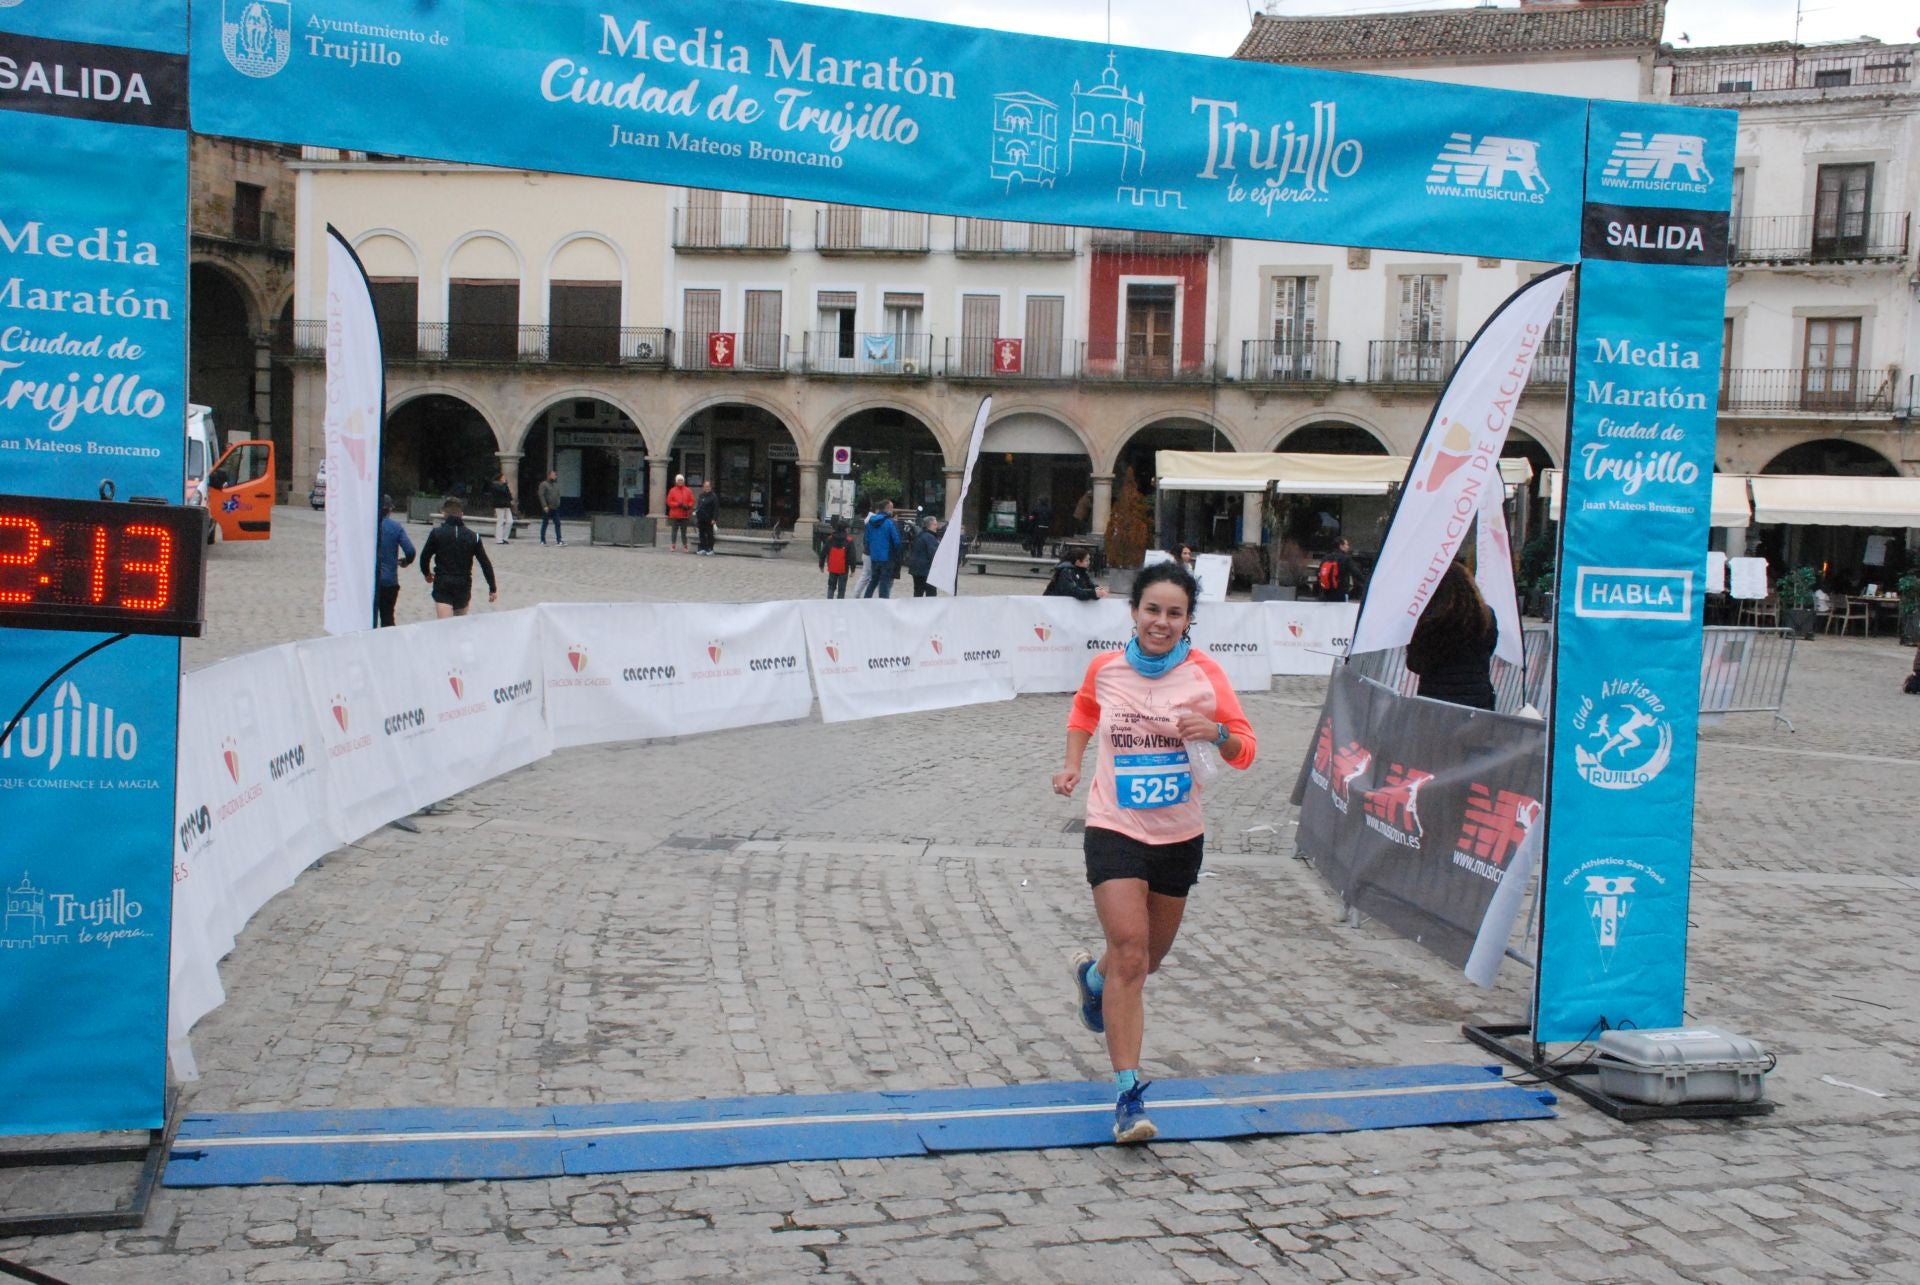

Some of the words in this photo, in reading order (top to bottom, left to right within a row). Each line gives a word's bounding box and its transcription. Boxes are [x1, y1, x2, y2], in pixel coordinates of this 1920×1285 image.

[307, 13, 424, 43] Ayuntamiento
[429, 30, 449, 46] de
[304, 34, 402, 69] Trujillo
[598, 14, 750, 75] Media
[765, 38, 957, 100] Maratón
[0, 54, 151, 106] SALIDA
[539, 58, 701, 118] Ciudad
[707, 84, 763, 124] de
[774, 87, 919, 153] Trujillo
[609, 124, 660, 149] Juan
[666, 131, 742, 158] Mateos
[748, 142, 844, 169] Broncano
[1191, 96, 1362, 192] Trujillo
[1228, 174, 1248, 204] te
[1426, 184, 1544, 205] www.musicrun.es
[1601, 176, 1707, 194] www.musicrun.es
[0, 221, 160, 267] Media
[1606, 221, 1704, 252] SALIDA
[0, 277, 171, 321] Maratón
[1, 326, 105, 357] Ciudad
[107, 337, 145, 360] de
[1593, 338, 1700, 369] Media
[0, 360, 166, 431] rujillo
[1586, 380, 1708, 410] Maratón
[1597, 417, 1659, 440] Ciudad
[1660, 423, 1685, 441] de
[0, 439, 20, 450] an
[25, 437, 82, 454] Mateos
[87, 441, 160, 458] Broncano
[1580, 442, 1699, 496] Trujillo
[1582, 499, 1606, 512] Juan
[1609, 500, 1646, 512] Mateos
[1649, 502, 1695, 514] Broncano
[1407, 477, 1481, 618] DIPUTACIÓN
[1472, 440, 1496, 473] DE
[1591, 582, 1674, 606] HABLA
[1573, 694, 1593, 730] Club
[1602, 678, 1665, 712] Atletismo
[0, 680, 138, 771] rujillo
[1111, 734, 1133, 748] OCIO
[1144, 734, 1184, 748] AVENTU
[0, 777, 25, 789] QUE
[28, 778, 95, 790] COMIENCE
[100, 779, 114, 789] LA
[118, 779, 160, 789] MAGIA
[1581, 763, 1650, 784] TRUJILLO
[1131, 777, 1179, 804] 525
[1453, 849, 1504, 883] www.musicr
[1563, 868, 1580, 885] Club
[1626, 859, 1645, 870] San
[50, 888, 143, 927] Trujillo
[78, 926, 93, 943] te
